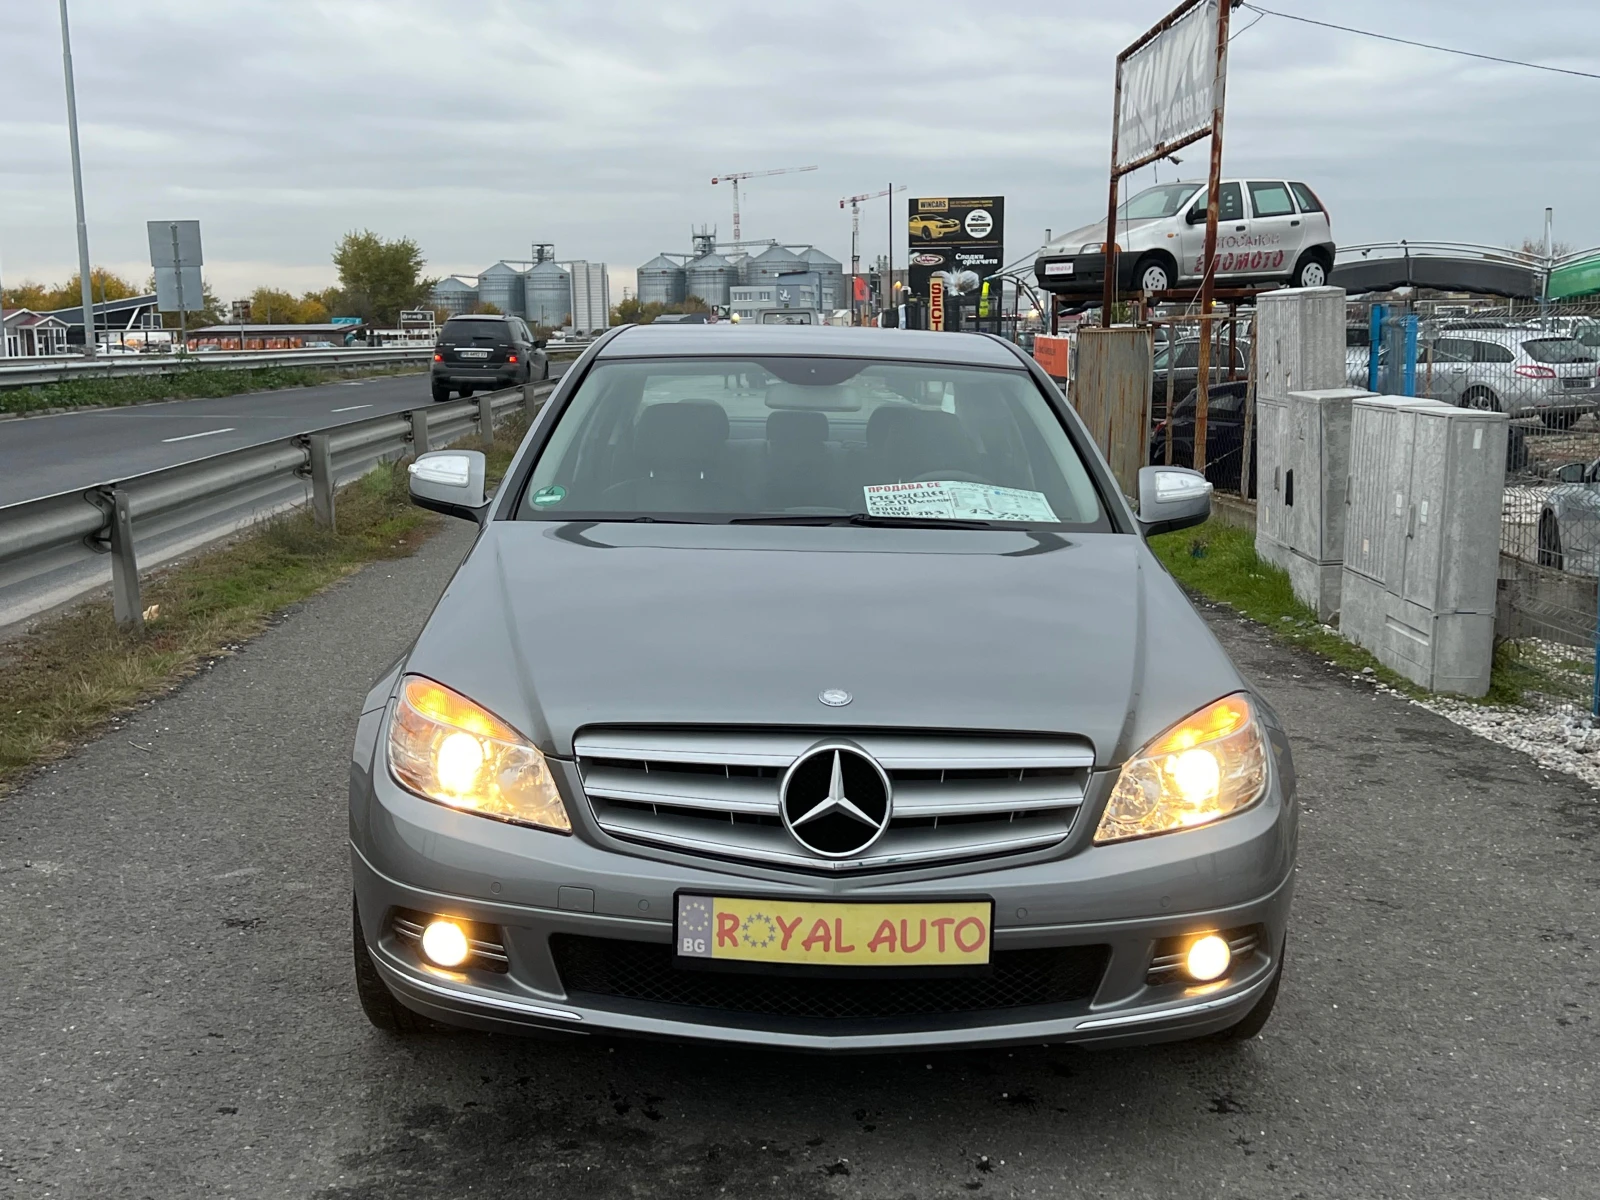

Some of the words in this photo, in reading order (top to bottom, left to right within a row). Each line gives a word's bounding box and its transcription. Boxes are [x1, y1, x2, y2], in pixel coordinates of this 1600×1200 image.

[1201, 233, 1280, 248] ТОСАЛОН
[545, 486, 555, 495] 4
[868, 483, 923, 493] ПРОДАВА
[927, 481, 941, 489] СЕ
[867, 916, 986, 953] AUTO
[683, 938, 705, 953] BG
